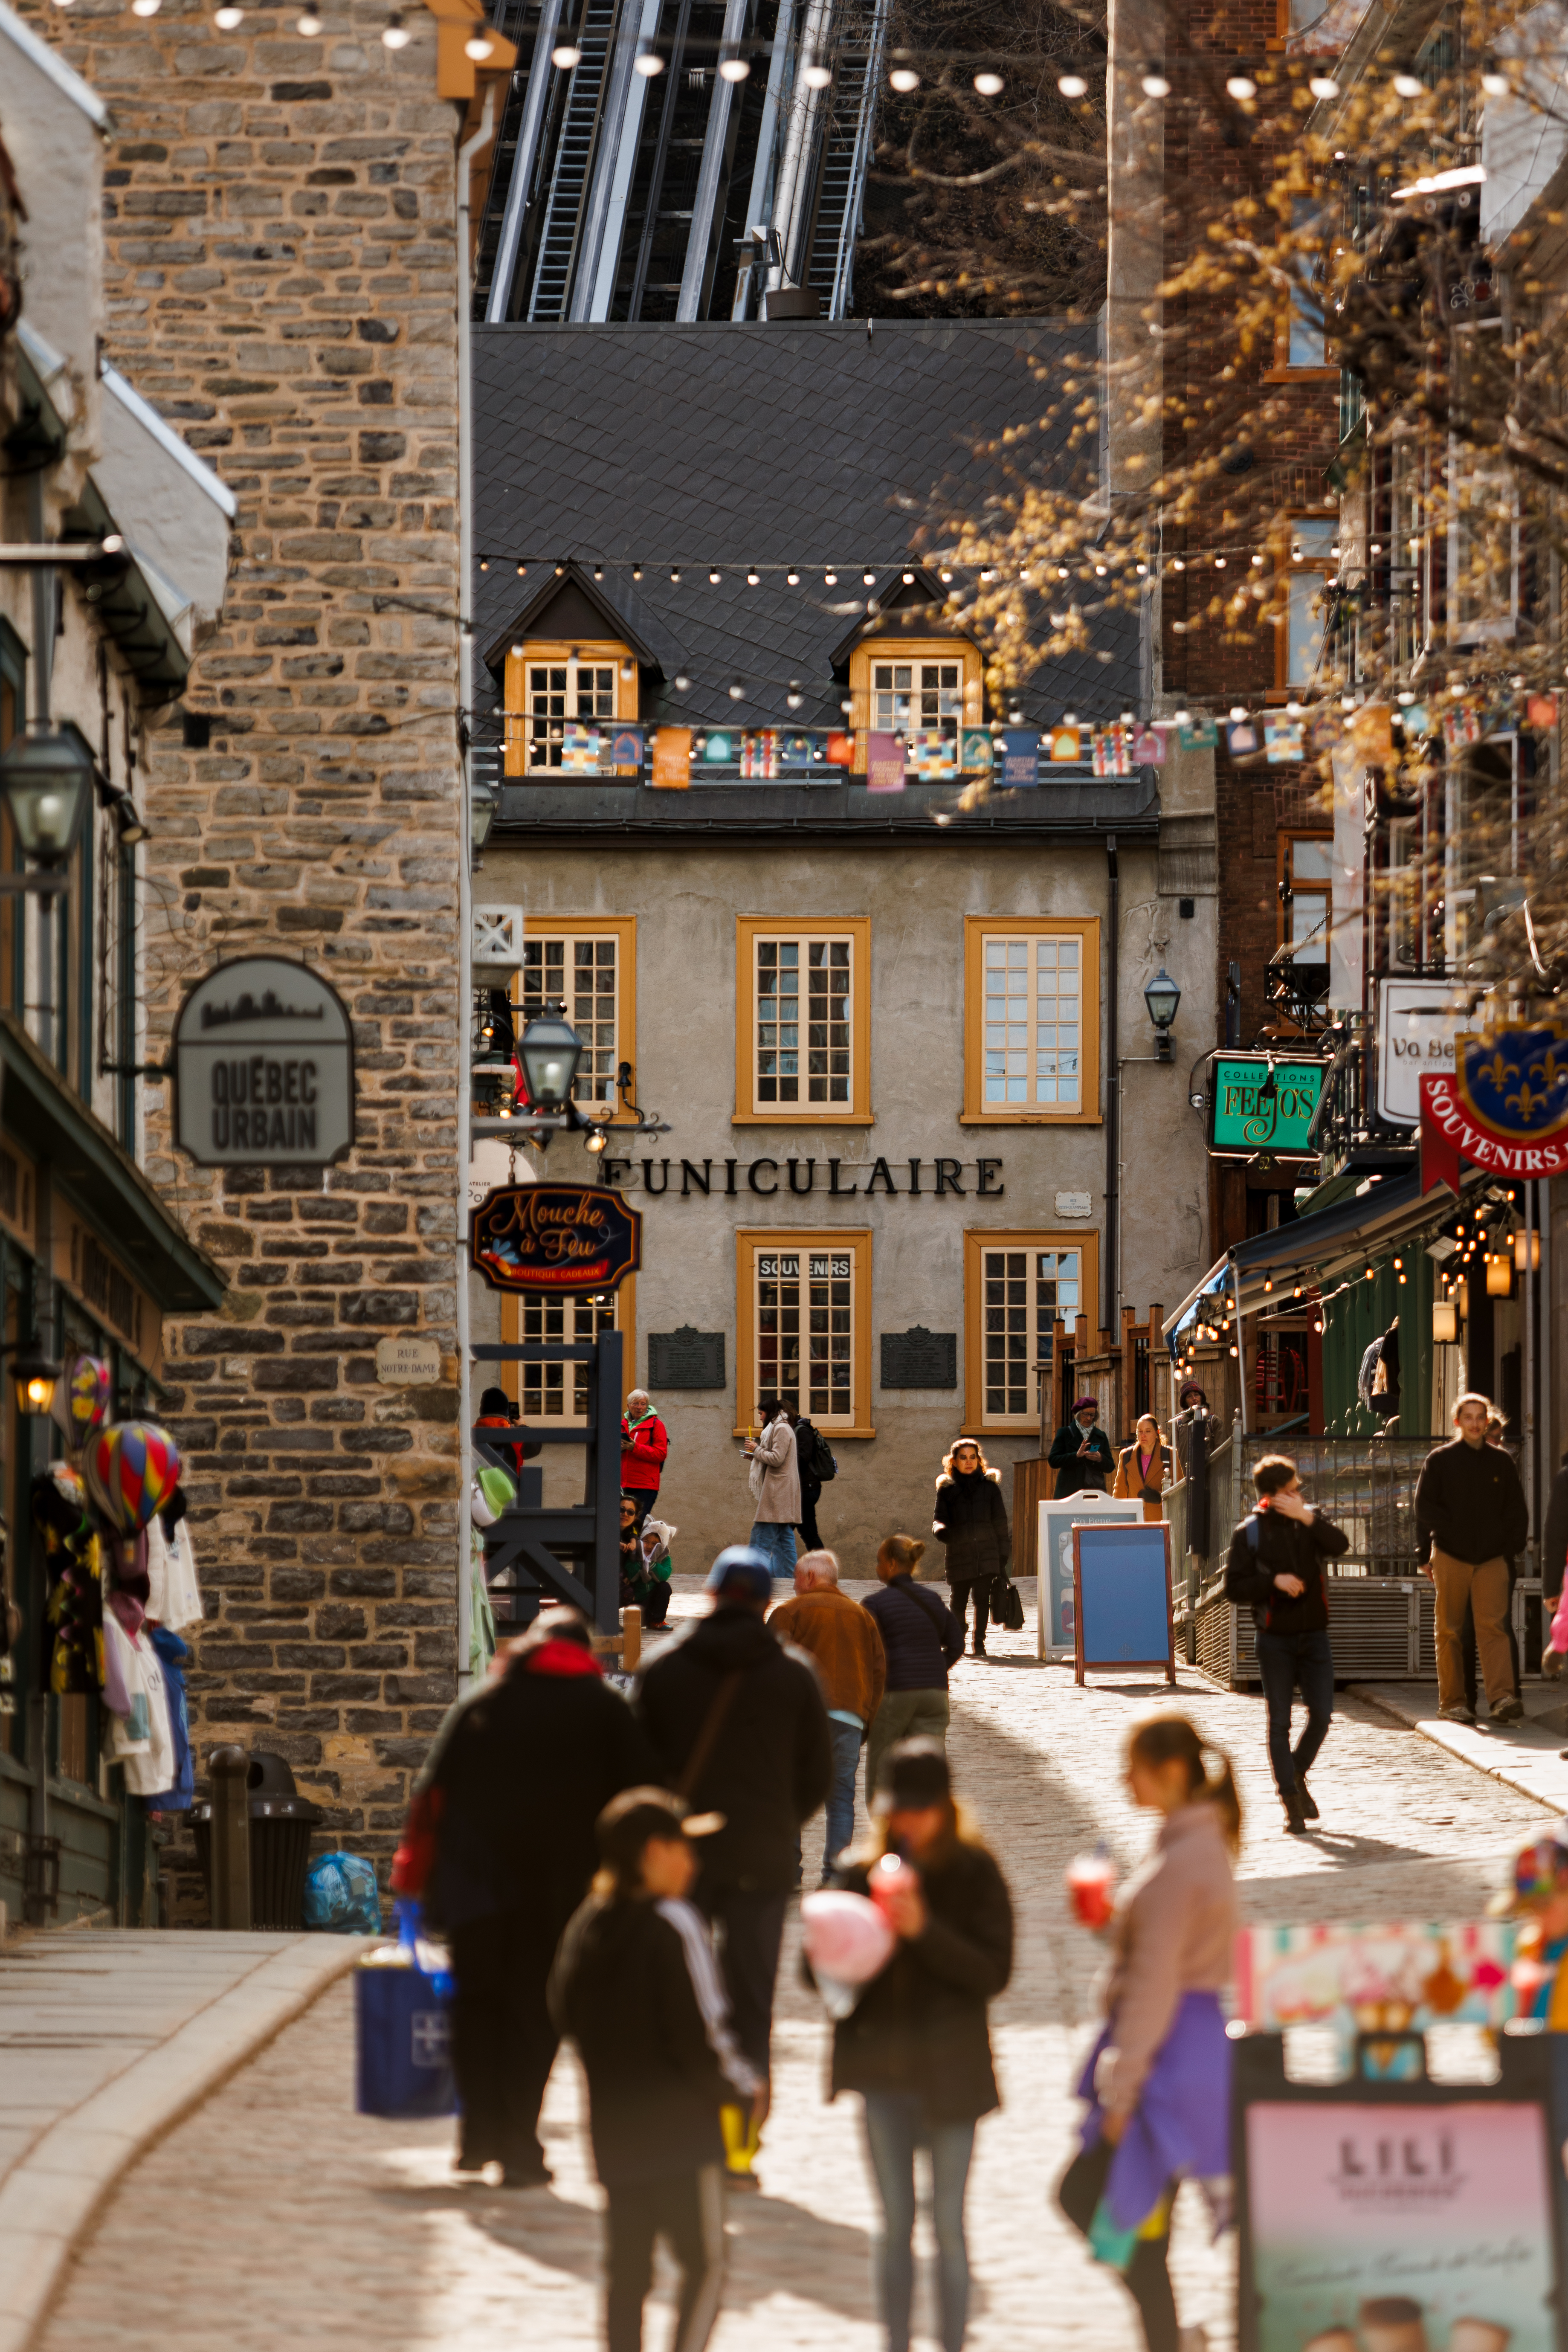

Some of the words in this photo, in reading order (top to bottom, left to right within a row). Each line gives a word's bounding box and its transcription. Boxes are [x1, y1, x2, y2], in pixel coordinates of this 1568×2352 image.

[1392, 1038, 1421, 1057] Va
[212, 1054, 316, 1108] QUÉBEC
[1224, 1071, 1314, 1082] COLLETIONS
[212, 1108, 316, 1150] URBAIN
[1426, 1080, 1560, 1171] SOUVENIRS
[603, 1157, 1004, 1194] FUNICULAIRE
[1259, 1156, 1270, 1169] 52
[489, 1190, 604, 1235] Mouche
[521, 1232, 535, 1253] à
[540, 1228, 596, 1259] Feu
[512, 1268, 556, 1279] BOUTIQUE
[560, 1267, 600, 1279] CADEAUX
[397, 1349, 418, 1358] RUE
[1338, 2132, 1455, 2175] LILI
